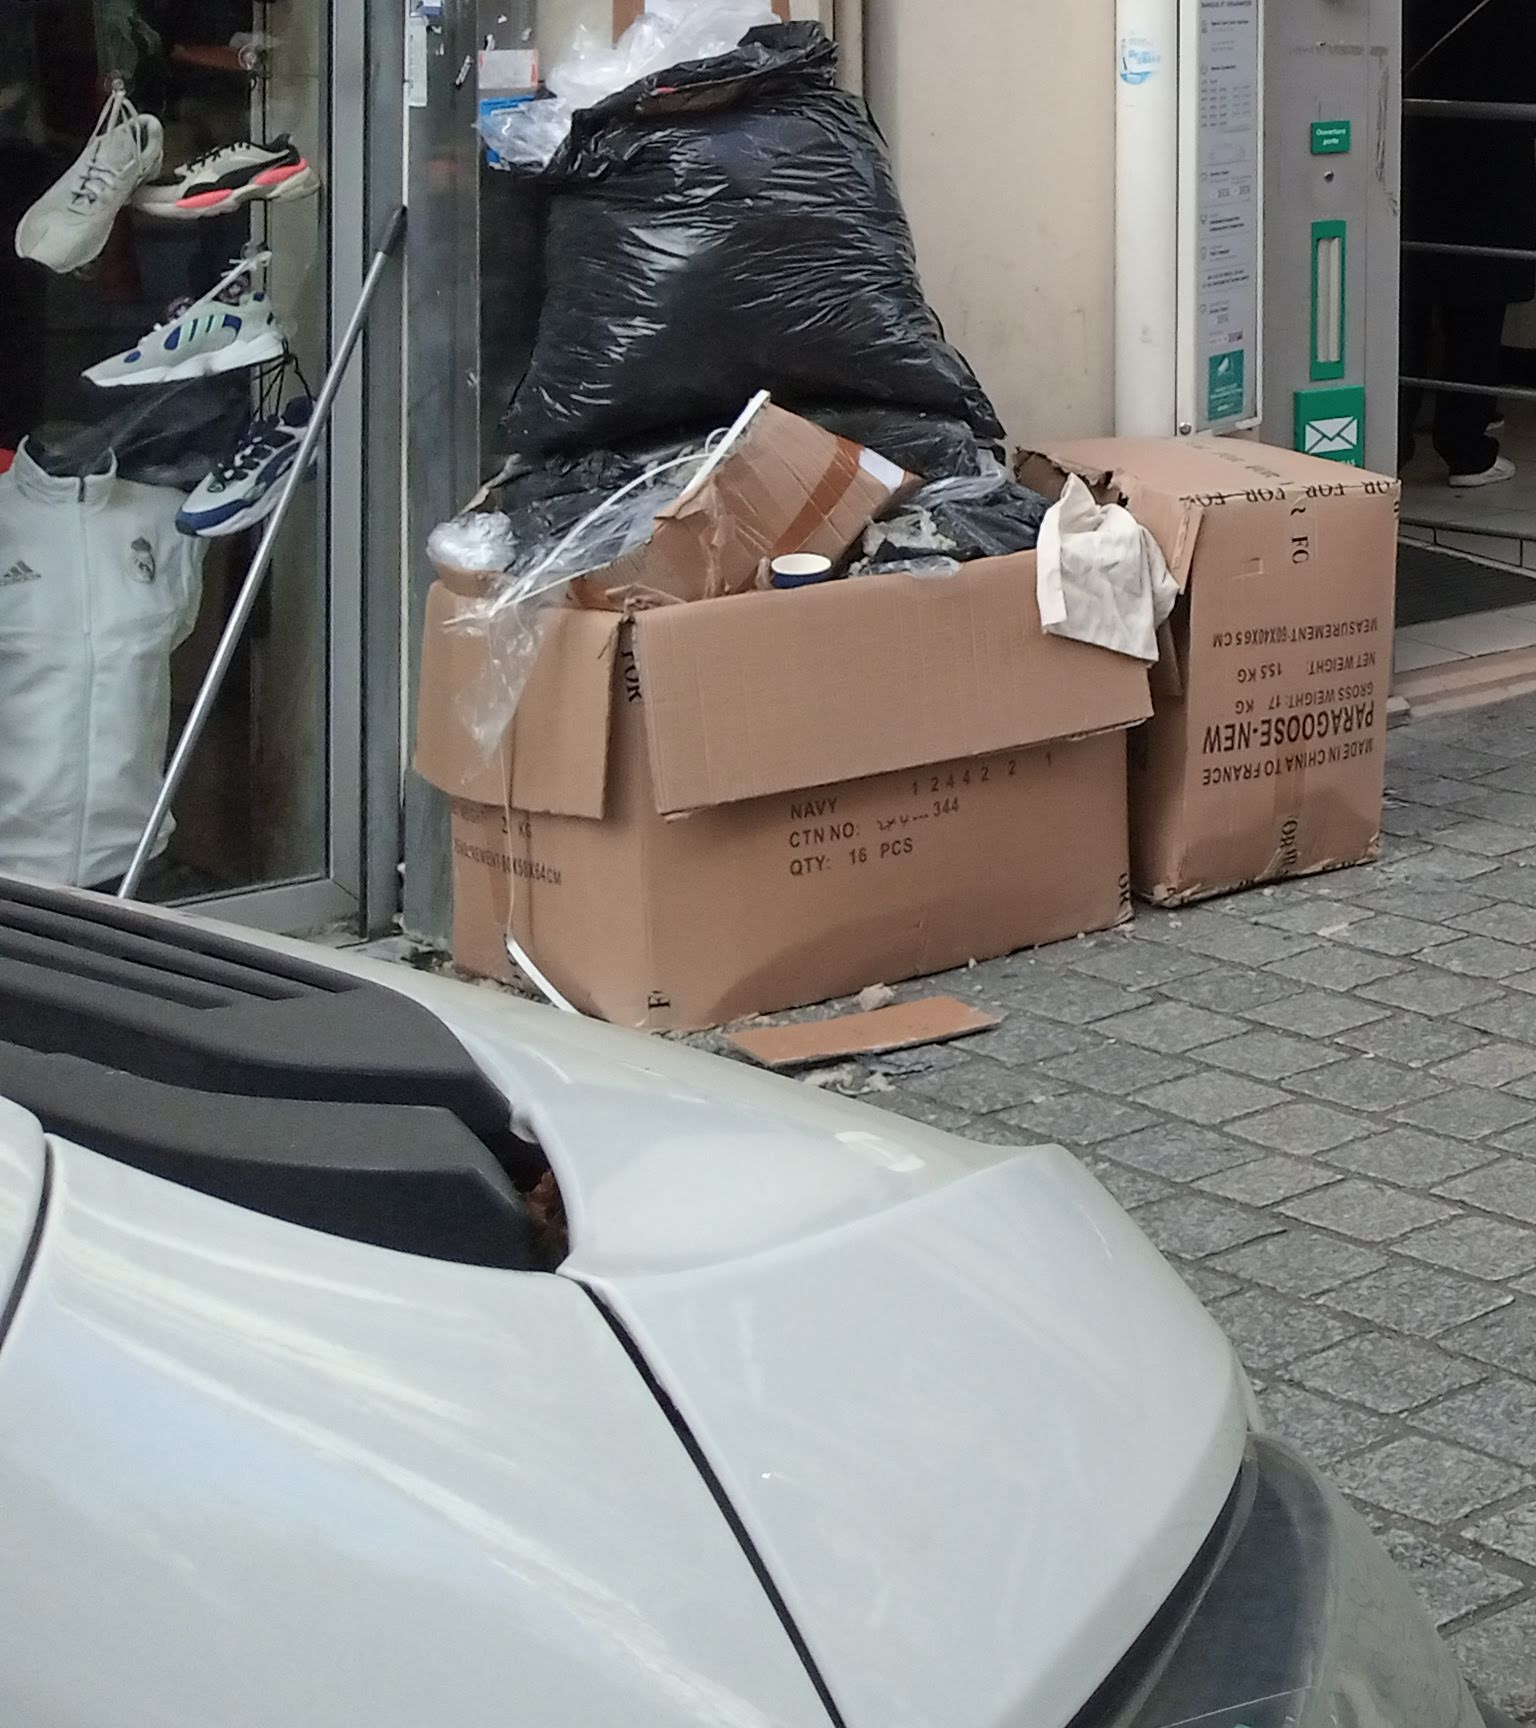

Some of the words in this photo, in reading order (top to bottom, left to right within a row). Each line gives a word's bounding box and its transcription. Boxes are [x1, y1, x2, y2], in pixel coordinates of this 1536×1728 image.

[1213, 633, 1232, 648] CM
[1357, 652, 1376, 665] NET
[1237, 668, 1256, 683] KG
[1338, 682, 1374, 701] GROSS
[1235, 699, 1254, 714] KG
[1268, 695, 1281, 709] 17
[1203, 700, 1374, 754] PARAGOOSE-NEW
[1328, 746, 1340, 762] IN
[1344, 738, 1373, 762] MADE
[1264, 759, 1281, 776] TO
[1285, 749, 1325, 771] CHINA
[1203, 762, 1261, 785] FRANCE
[790, 797, 838, 819] NAVY
[789, 827, 825, 849] CTN
[829, 821, 861, 840] NO:
[790, 855, 831, 877] QTY:
[849, 846, 868, 865] 16
[880, 838, 914, 859] PCS
